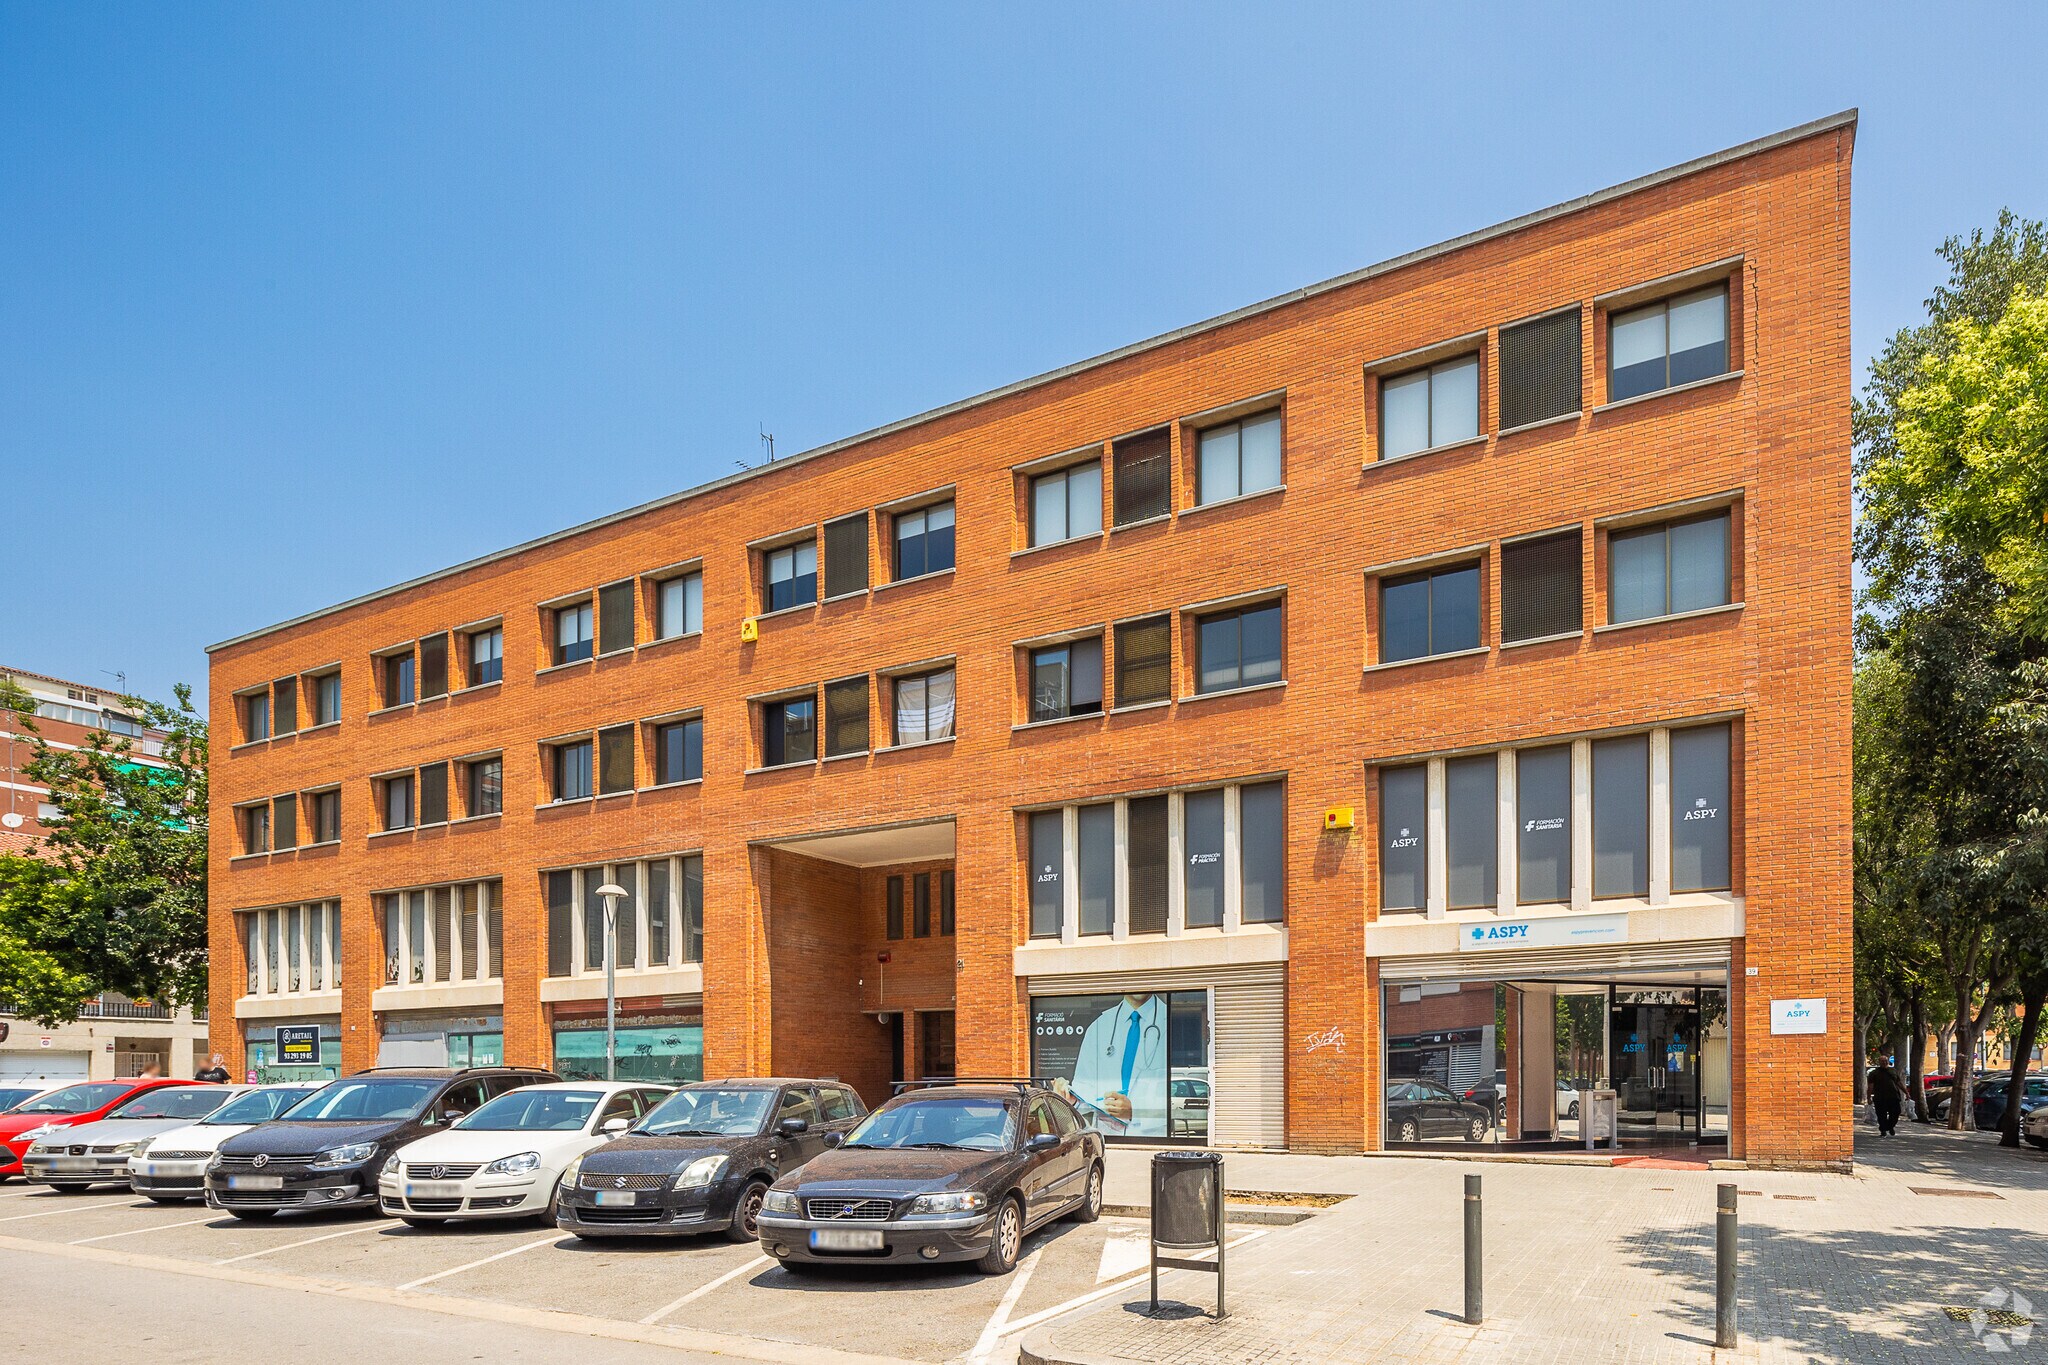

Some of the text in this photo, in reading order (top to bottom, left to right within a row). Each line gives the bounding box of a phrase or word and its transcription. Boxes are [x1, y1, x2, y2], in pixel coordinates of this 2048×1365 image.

[1683, 808, 1718, 821] ASPY
[1536, 817, 1565, 825] FORMACIÓN
[1535, 823, 1563, 831] SANITARIA
[1390, 837, 1419, 848] ASPY
[1037, 873, 1059, 883] ASPY
[1487, 924, 1529, 939] ASPY
[291, 1032, 313, 1040] ARETAIL
[1622, 1043, 1646, 1053] ASPY
[1666, 1043, 1688, 1053] ASPY
[283, 1052, 313, 1060] 93 293 19 05
